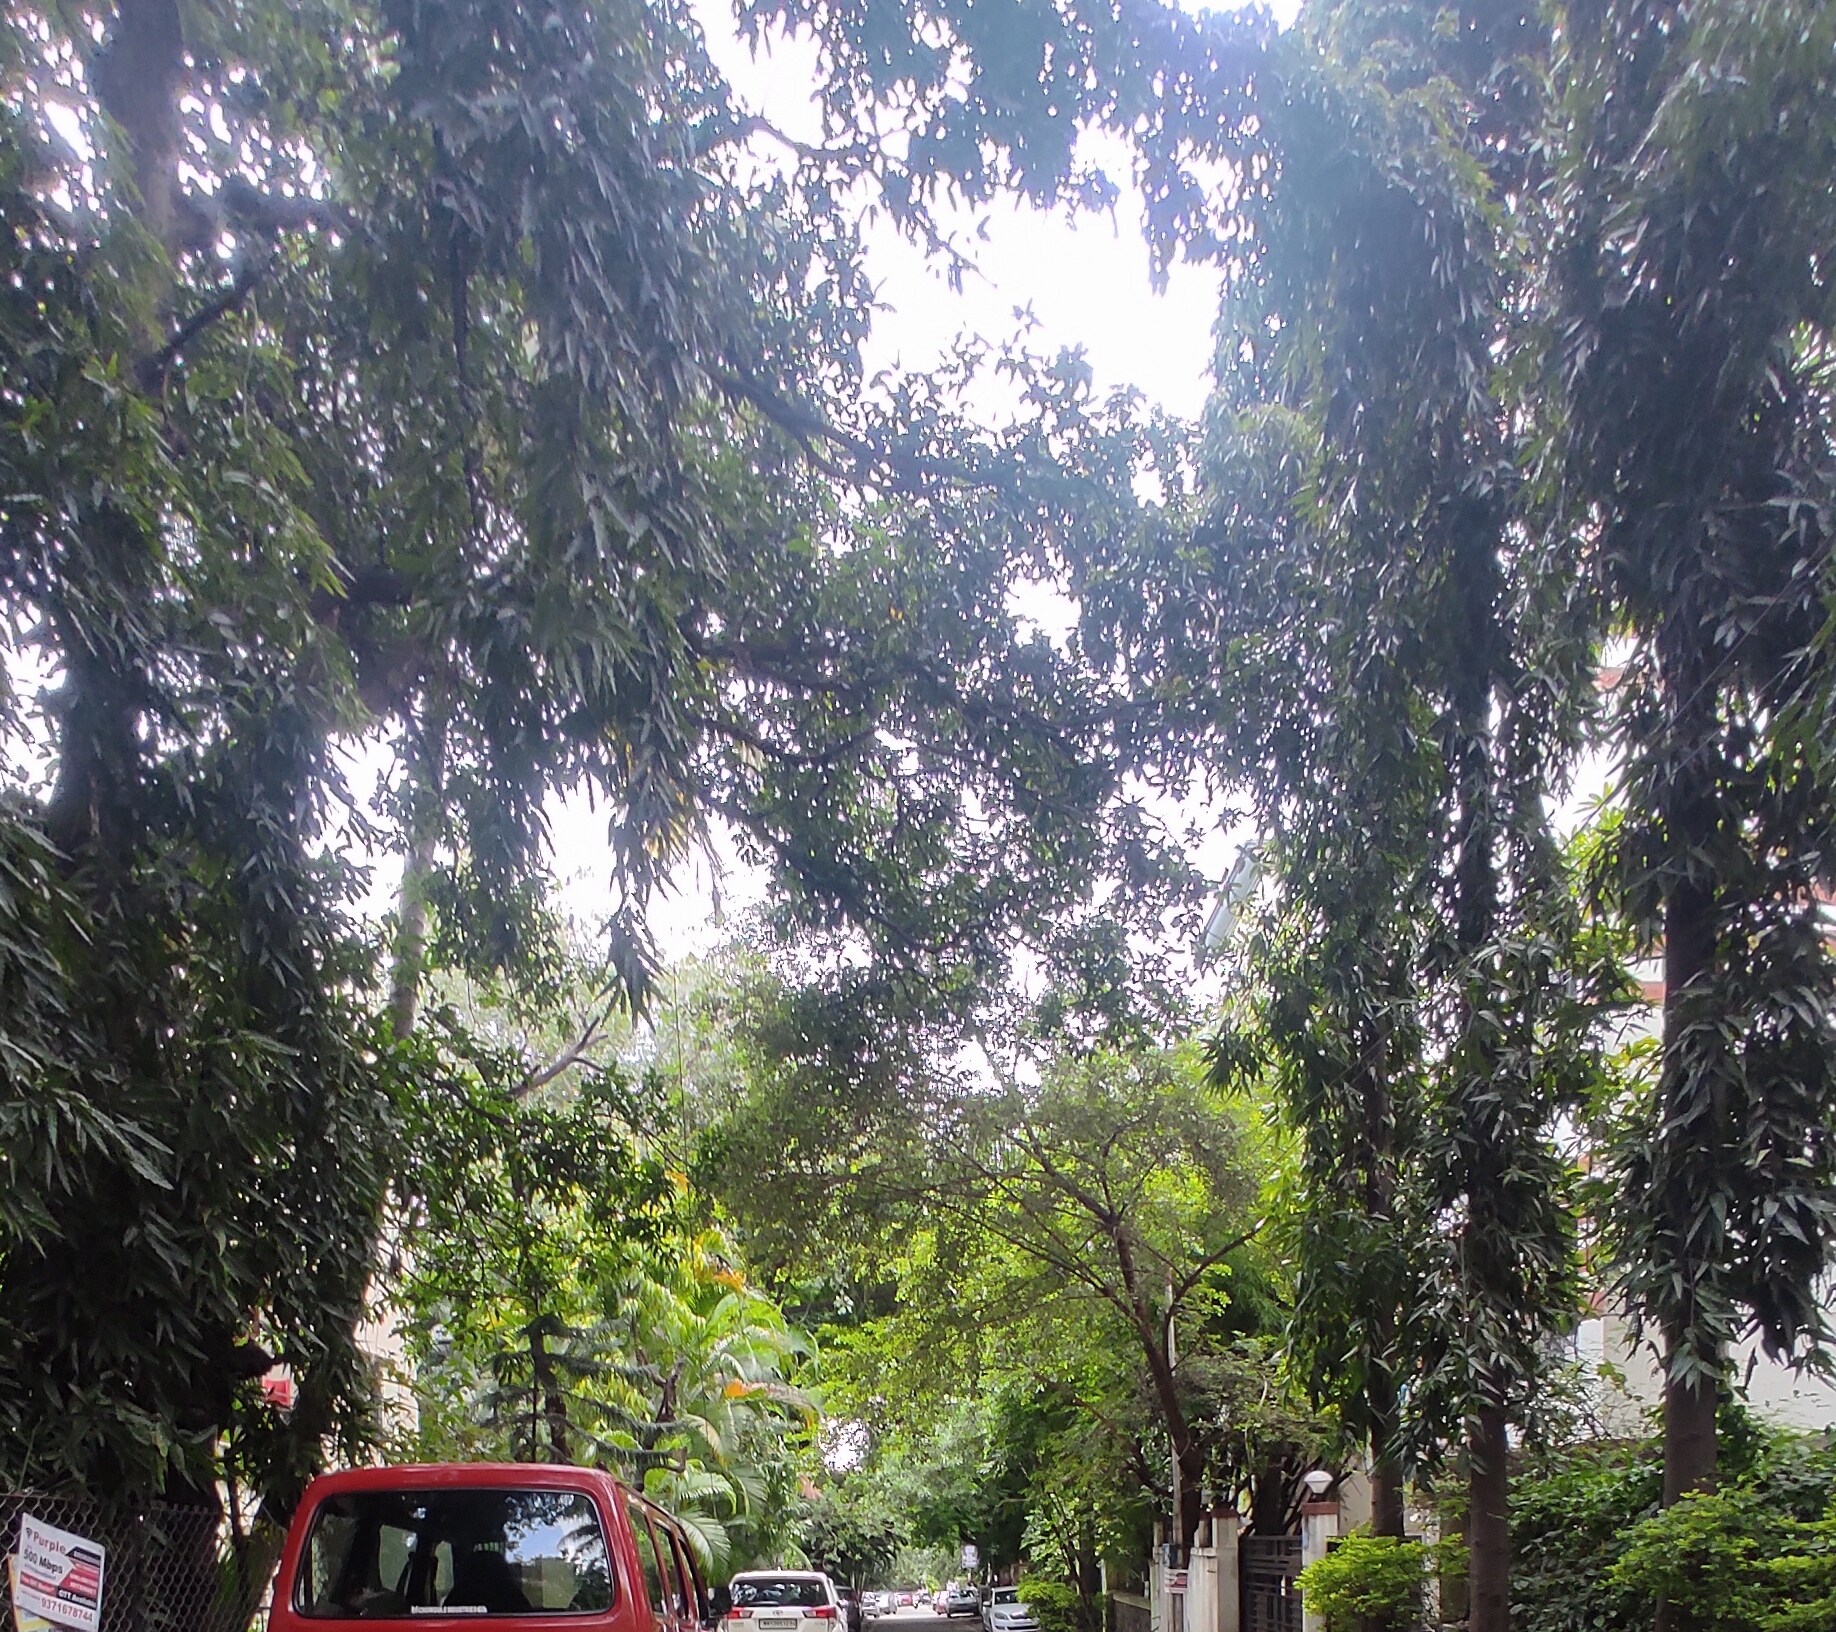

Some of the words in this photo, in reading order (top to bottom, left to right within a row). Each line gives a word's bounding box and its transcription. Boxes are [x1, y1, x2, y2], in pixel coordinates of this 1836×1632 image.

[33, 1531, 66, 1555] Purple
[24, 1549, 38, 1564] 500
[39, 1556, 63, 1574] Mbps
